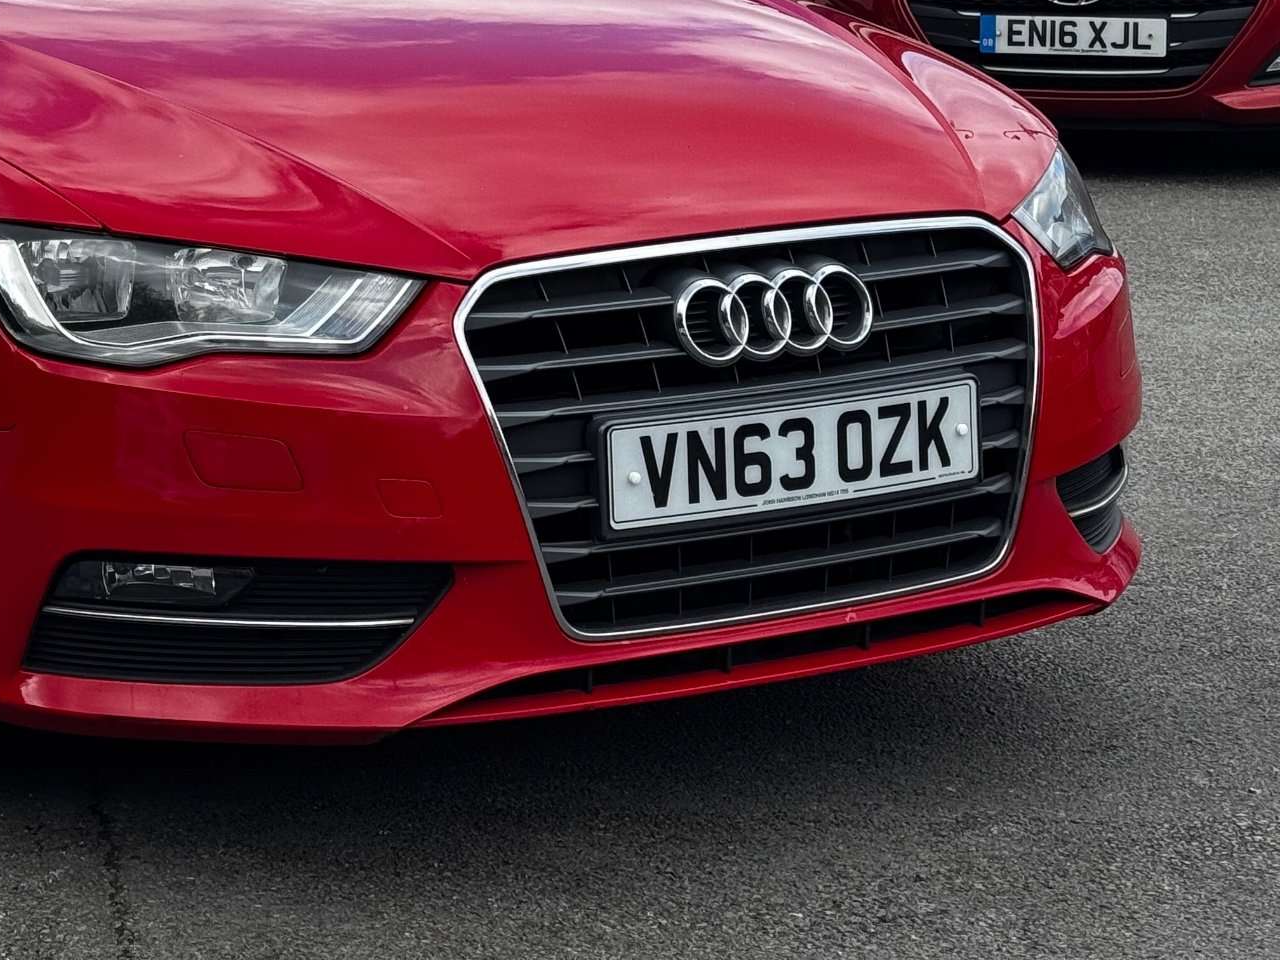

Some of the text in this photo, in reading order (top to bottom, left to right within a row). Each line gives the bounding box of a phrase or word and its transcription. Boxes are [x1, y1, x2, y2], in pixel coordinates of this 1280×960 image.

[1008, 20, 1152, 50] EN16 XJL
[640, 396, 951, 509] VN63 OZK
